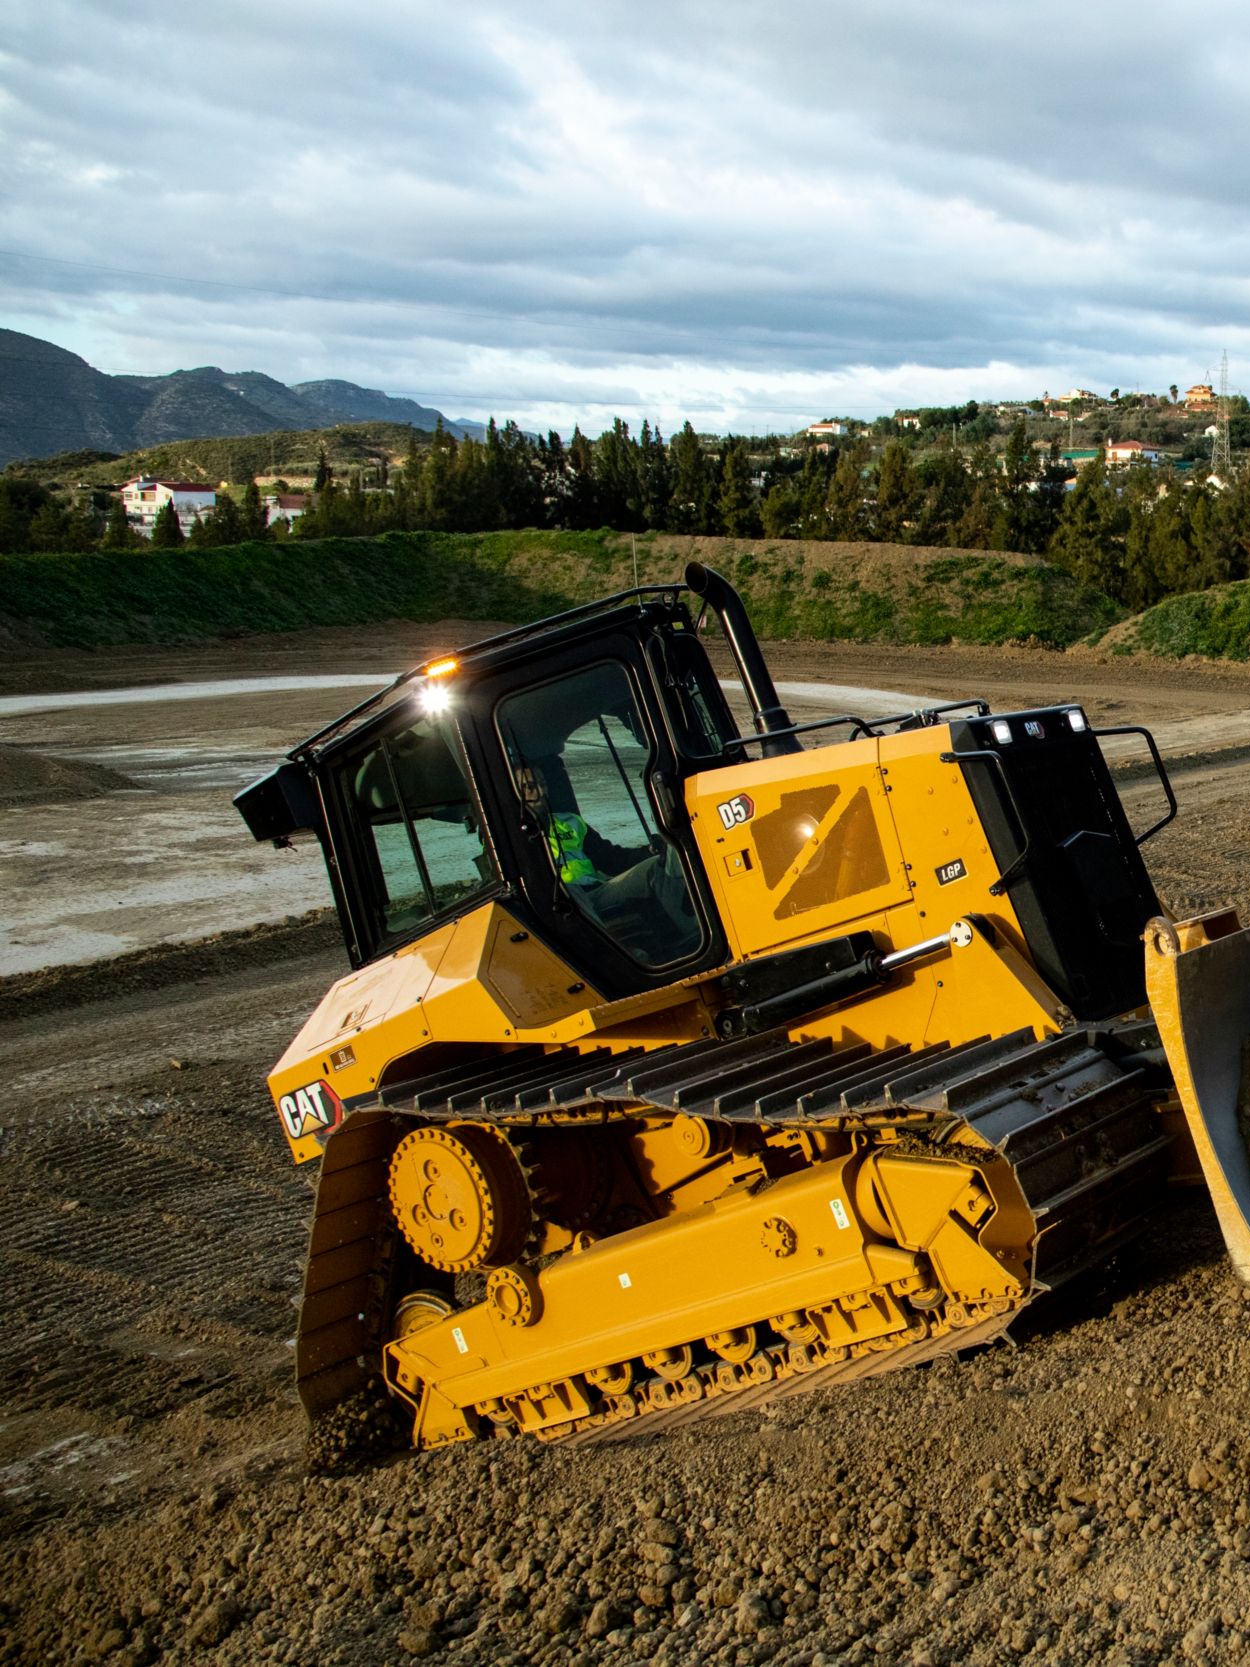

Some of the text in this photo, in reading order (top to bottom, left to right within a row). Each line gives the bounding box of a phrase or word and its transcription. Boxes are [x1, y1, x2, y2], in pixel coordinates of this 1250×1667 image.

[1024, 721, 1040, 736] CAT
[718, 797, 746, 829] D5
[941, 863, 960, 882] LGP
[280, 1081, 329, 1138] CAT
